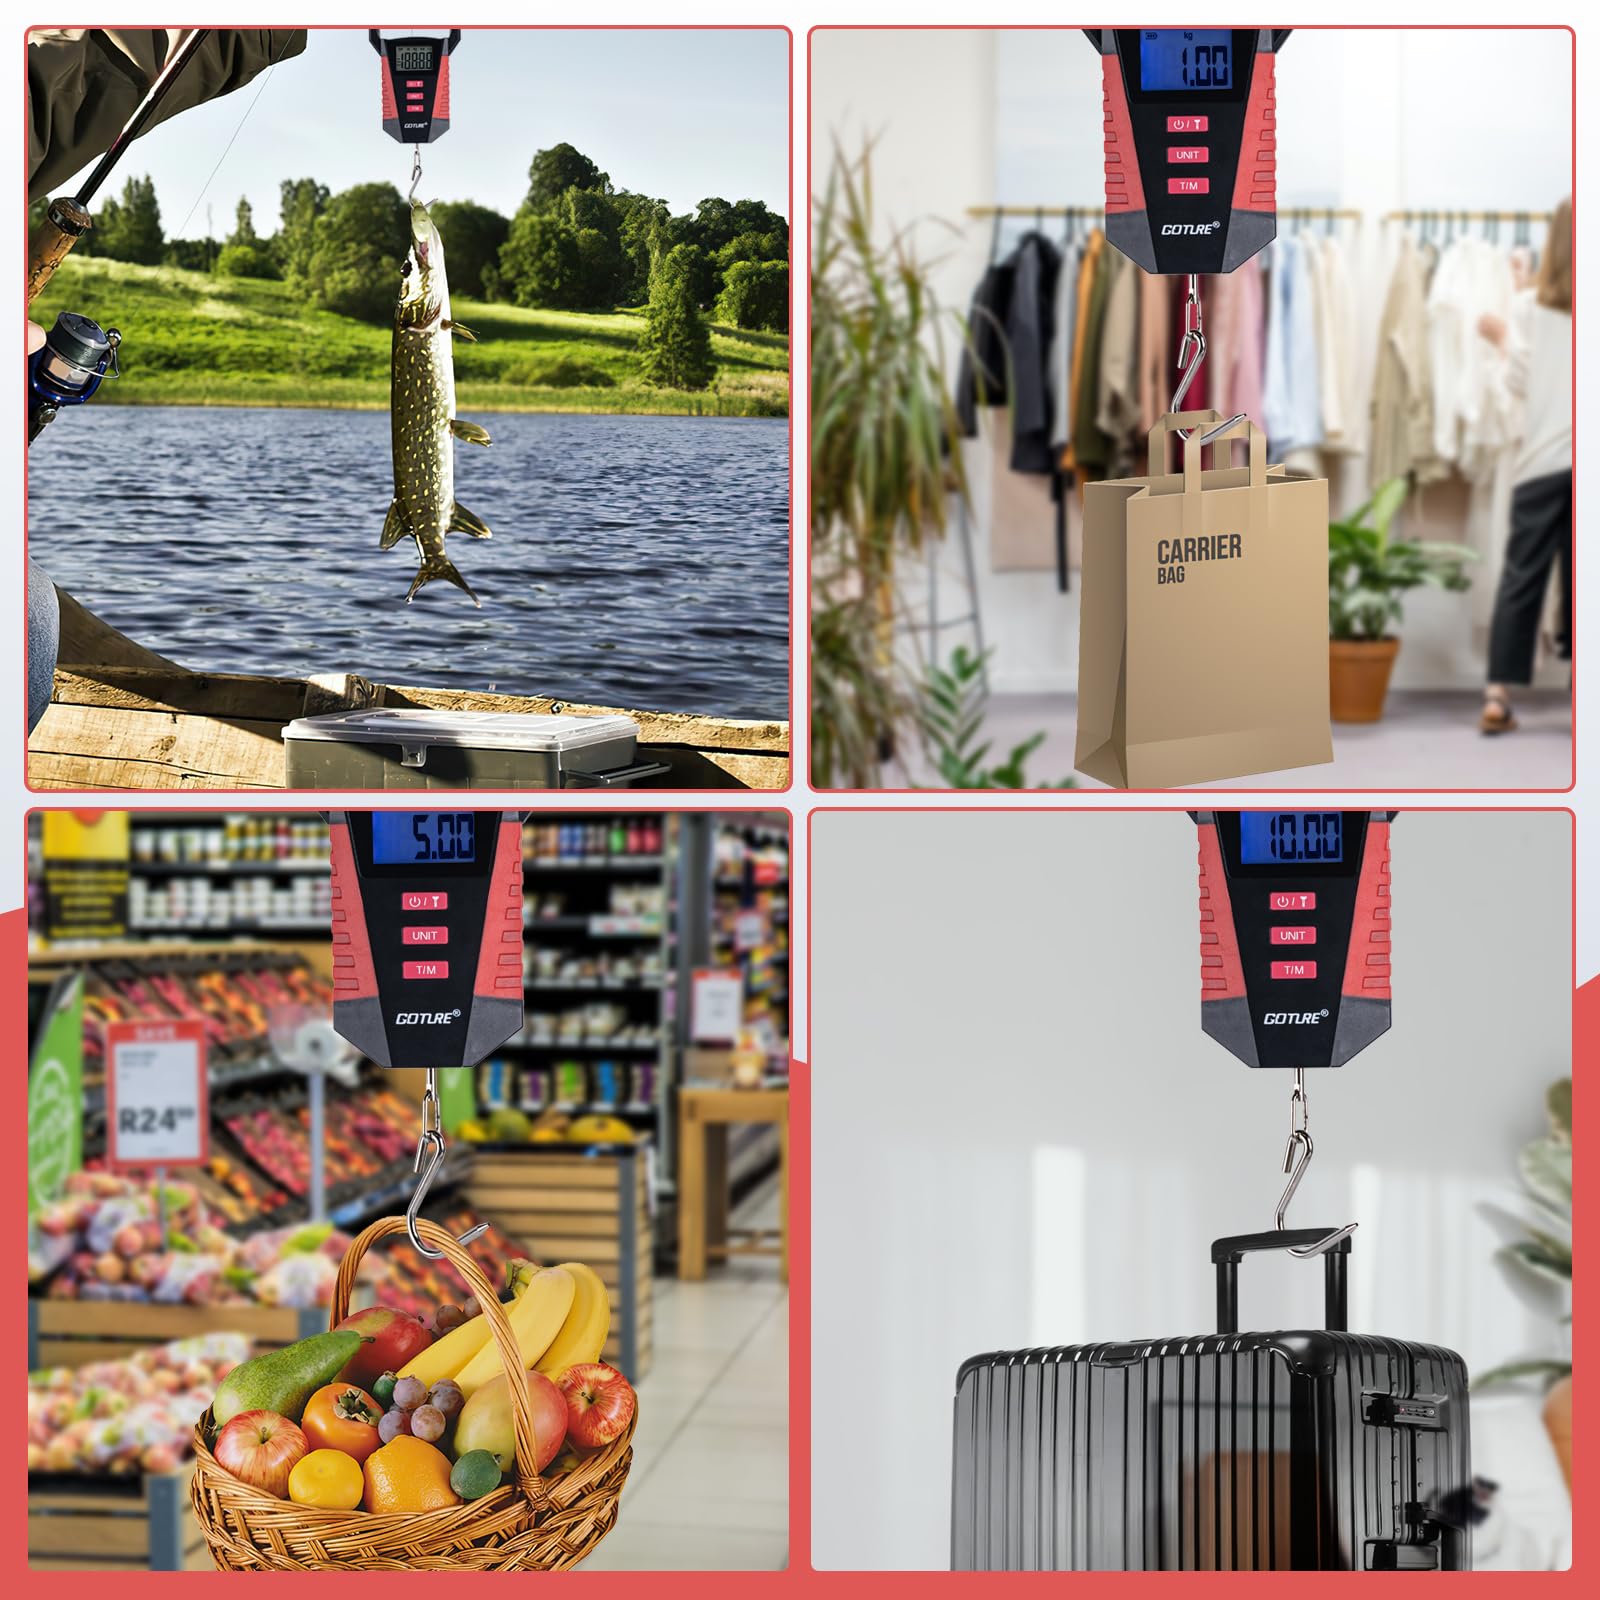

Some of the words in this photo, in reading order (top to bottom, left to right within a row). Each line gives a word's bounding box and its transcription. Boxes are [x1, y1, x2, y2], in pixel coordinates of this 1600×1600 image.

[1183, 31, 1193, 41] kg
[1182, 45, 1229, 86] 1.00
[1176, 151, 1200, 160] UNIT
[1179, 181, 1198, 190] T/M
[1157, 533, 1242, 565] CARRIER
[1157, 565, 1185, 585] BAG
[412, 813, 474, 860] 5.00
[1270, 813, 1340, 860] 10.00
[412, 931, 438, 940] UNIT
[1280, 931, 1306, 940] UNIT
[416, 965, 437, 975] T/M
[1283, 965, 1304, 975] T/M
